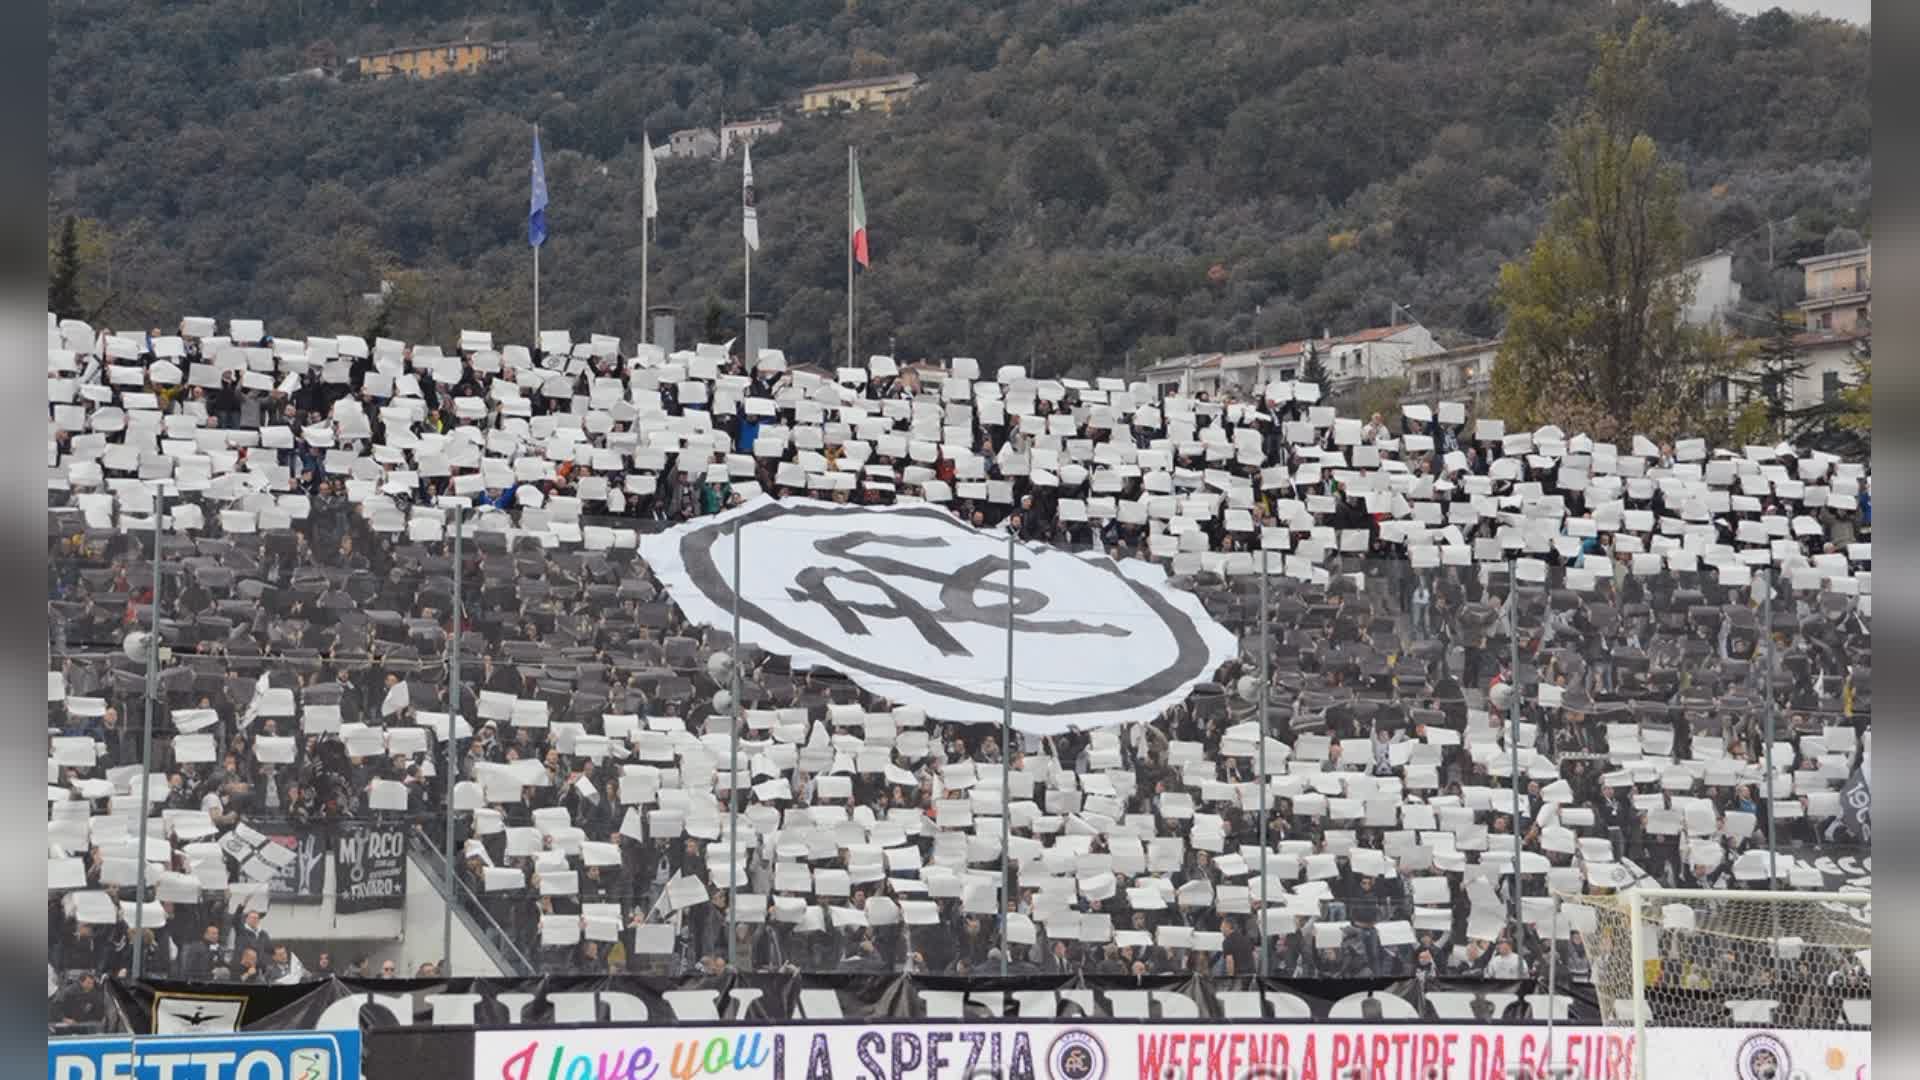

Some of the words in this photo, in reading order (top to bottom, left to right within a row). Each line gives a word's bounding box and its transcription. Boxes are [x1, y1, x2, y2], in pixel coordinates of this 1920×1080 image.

[549, 1045, 660, 1080] love
[669, 1031, 770, 1080] you
[856, 1030, 1034, 1080] SPEZIA
[1137, 1032, 1290, 1080] WEEKEND
[1301, 1033, 1318, 1080] A
[1469, 1033, 1505, 1080] DA
